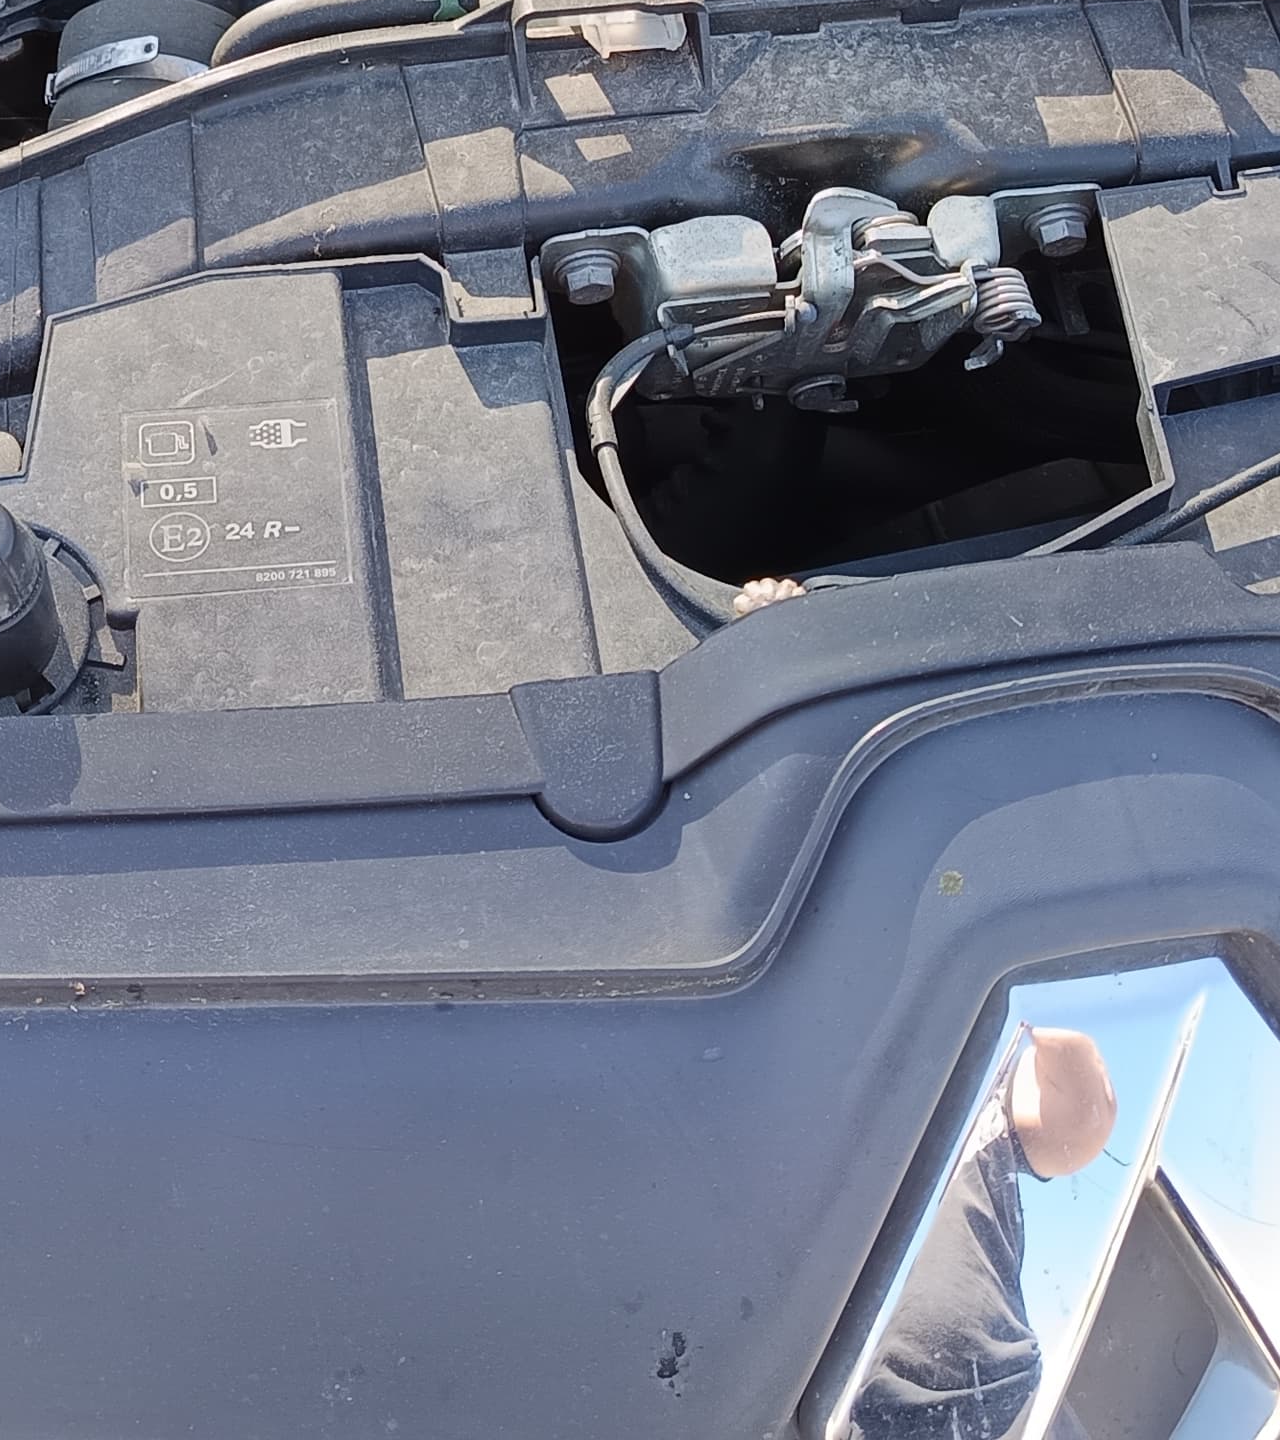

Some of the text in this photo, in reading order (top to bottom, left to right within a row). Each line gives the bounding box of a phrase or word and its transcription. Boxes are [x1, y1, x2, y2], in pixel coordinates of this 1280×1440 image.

[160, 483, 198, 501] 0,5
[160, 524, 203, 552] E2
[225, 522, 255, 540] 24
[256, 571, 285, 582] 8200
[288, 568, 310, 579] 721
